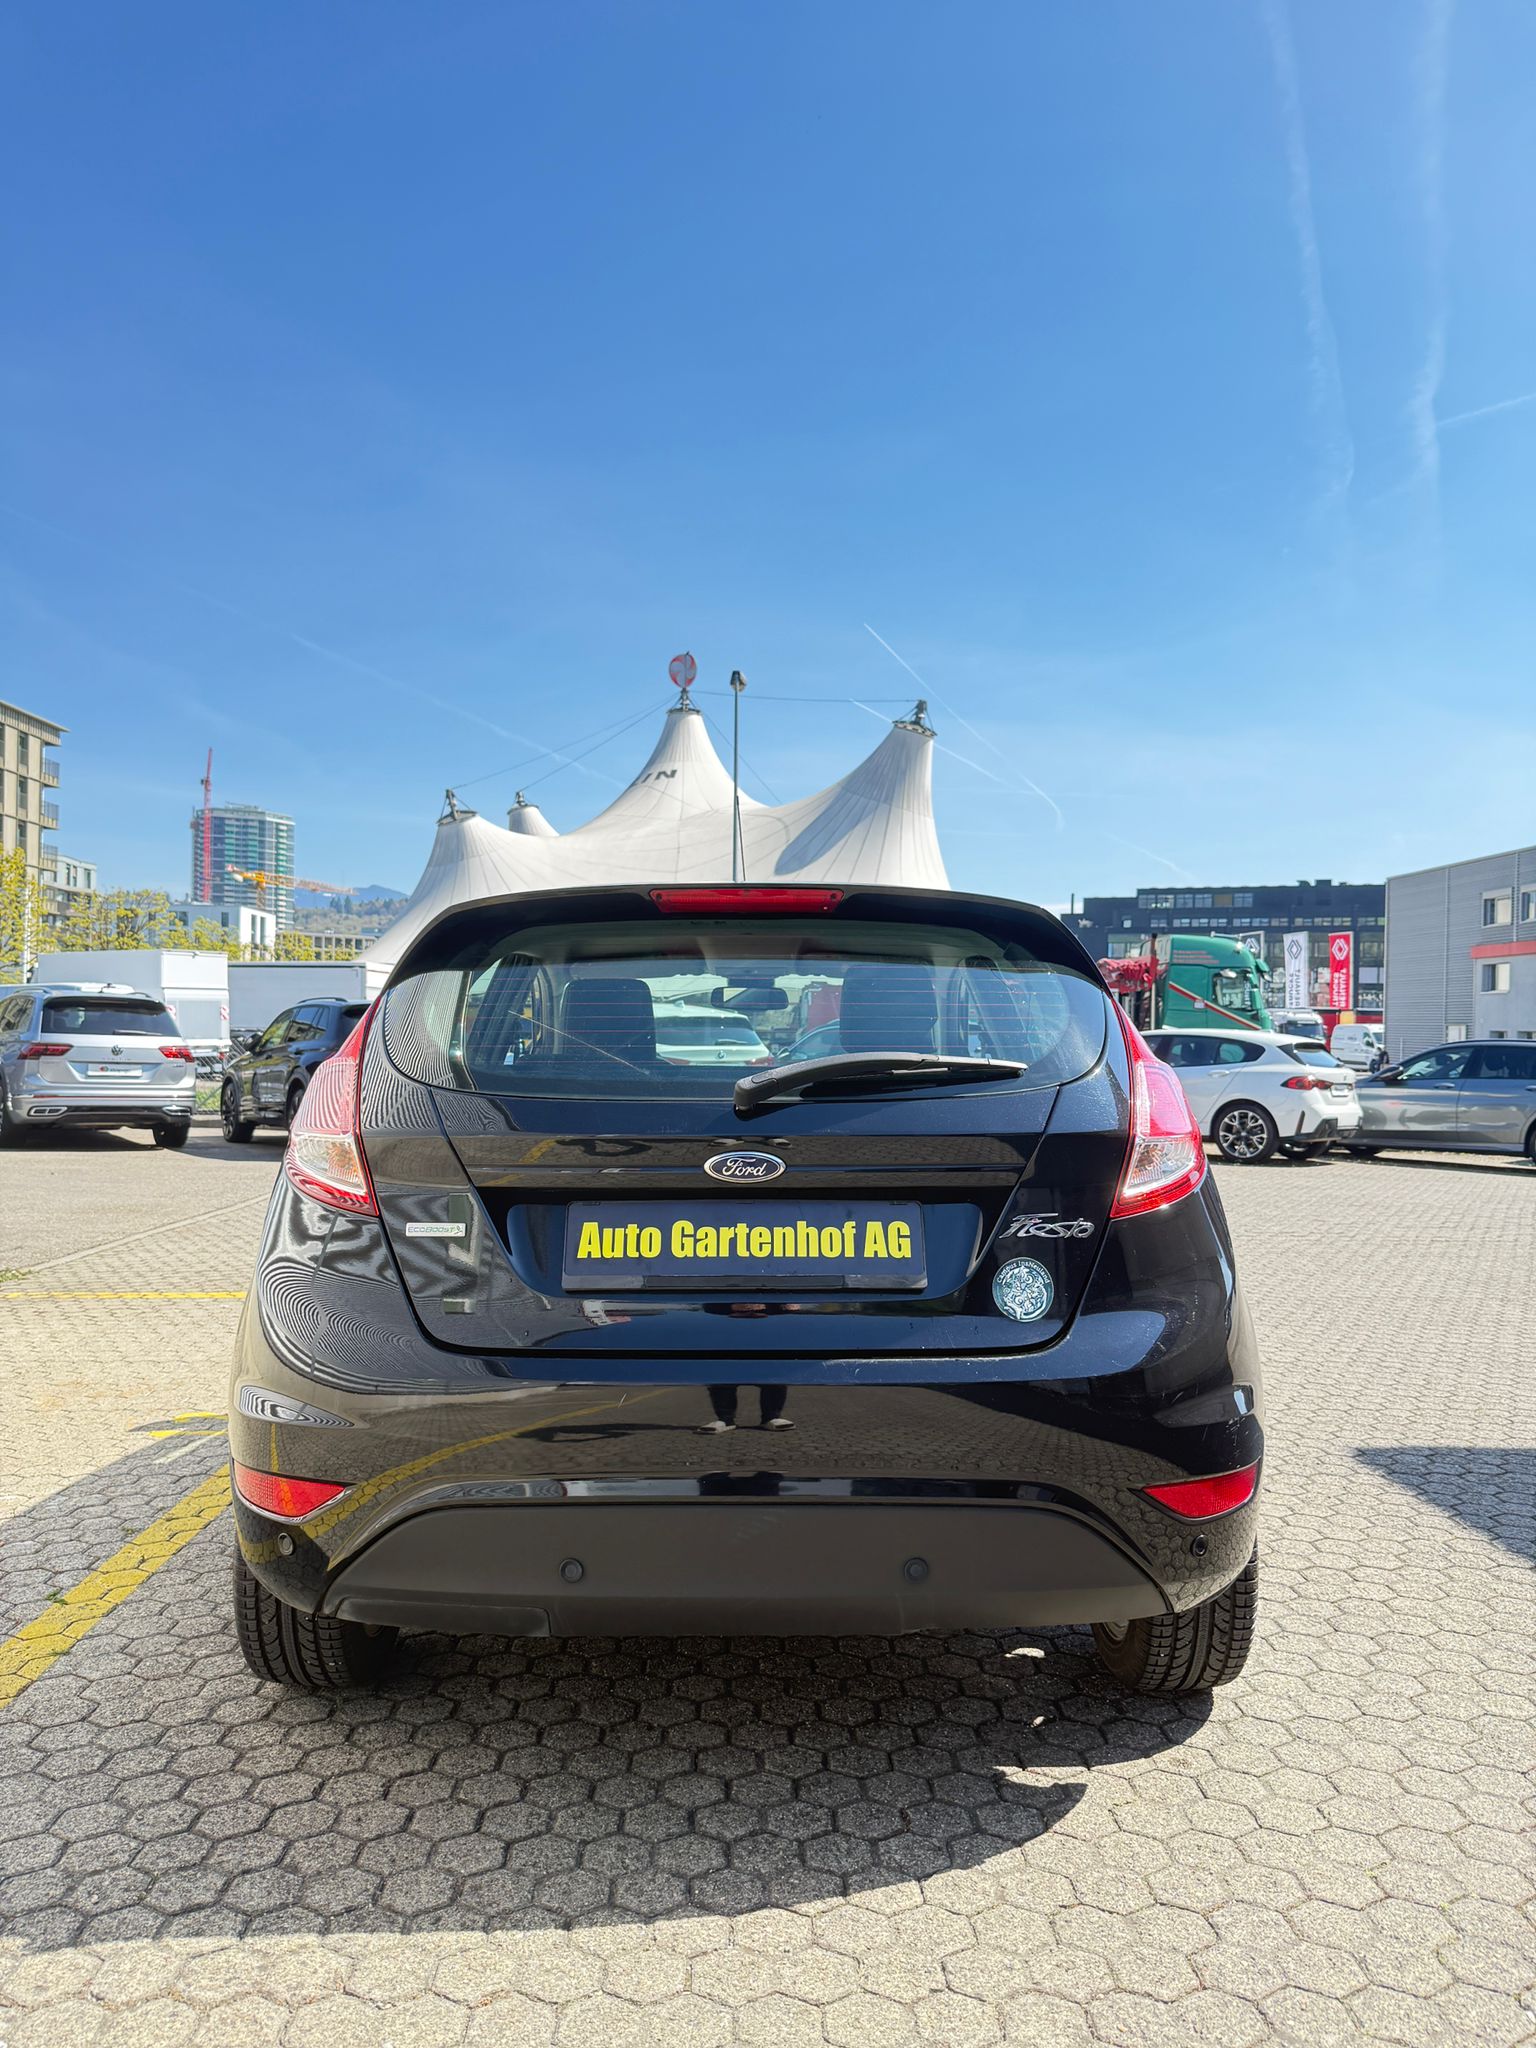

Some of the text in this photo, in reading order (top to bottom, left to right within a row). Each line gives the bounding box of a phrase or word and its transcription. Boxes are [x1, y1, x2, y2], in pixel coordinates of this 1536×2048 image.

[722, 1157, 768, 1176] Ford
[999, 1213, 1095, 1238] Fiesta
[576, 1220, 912, 1259] Auto Gartenhof AG
